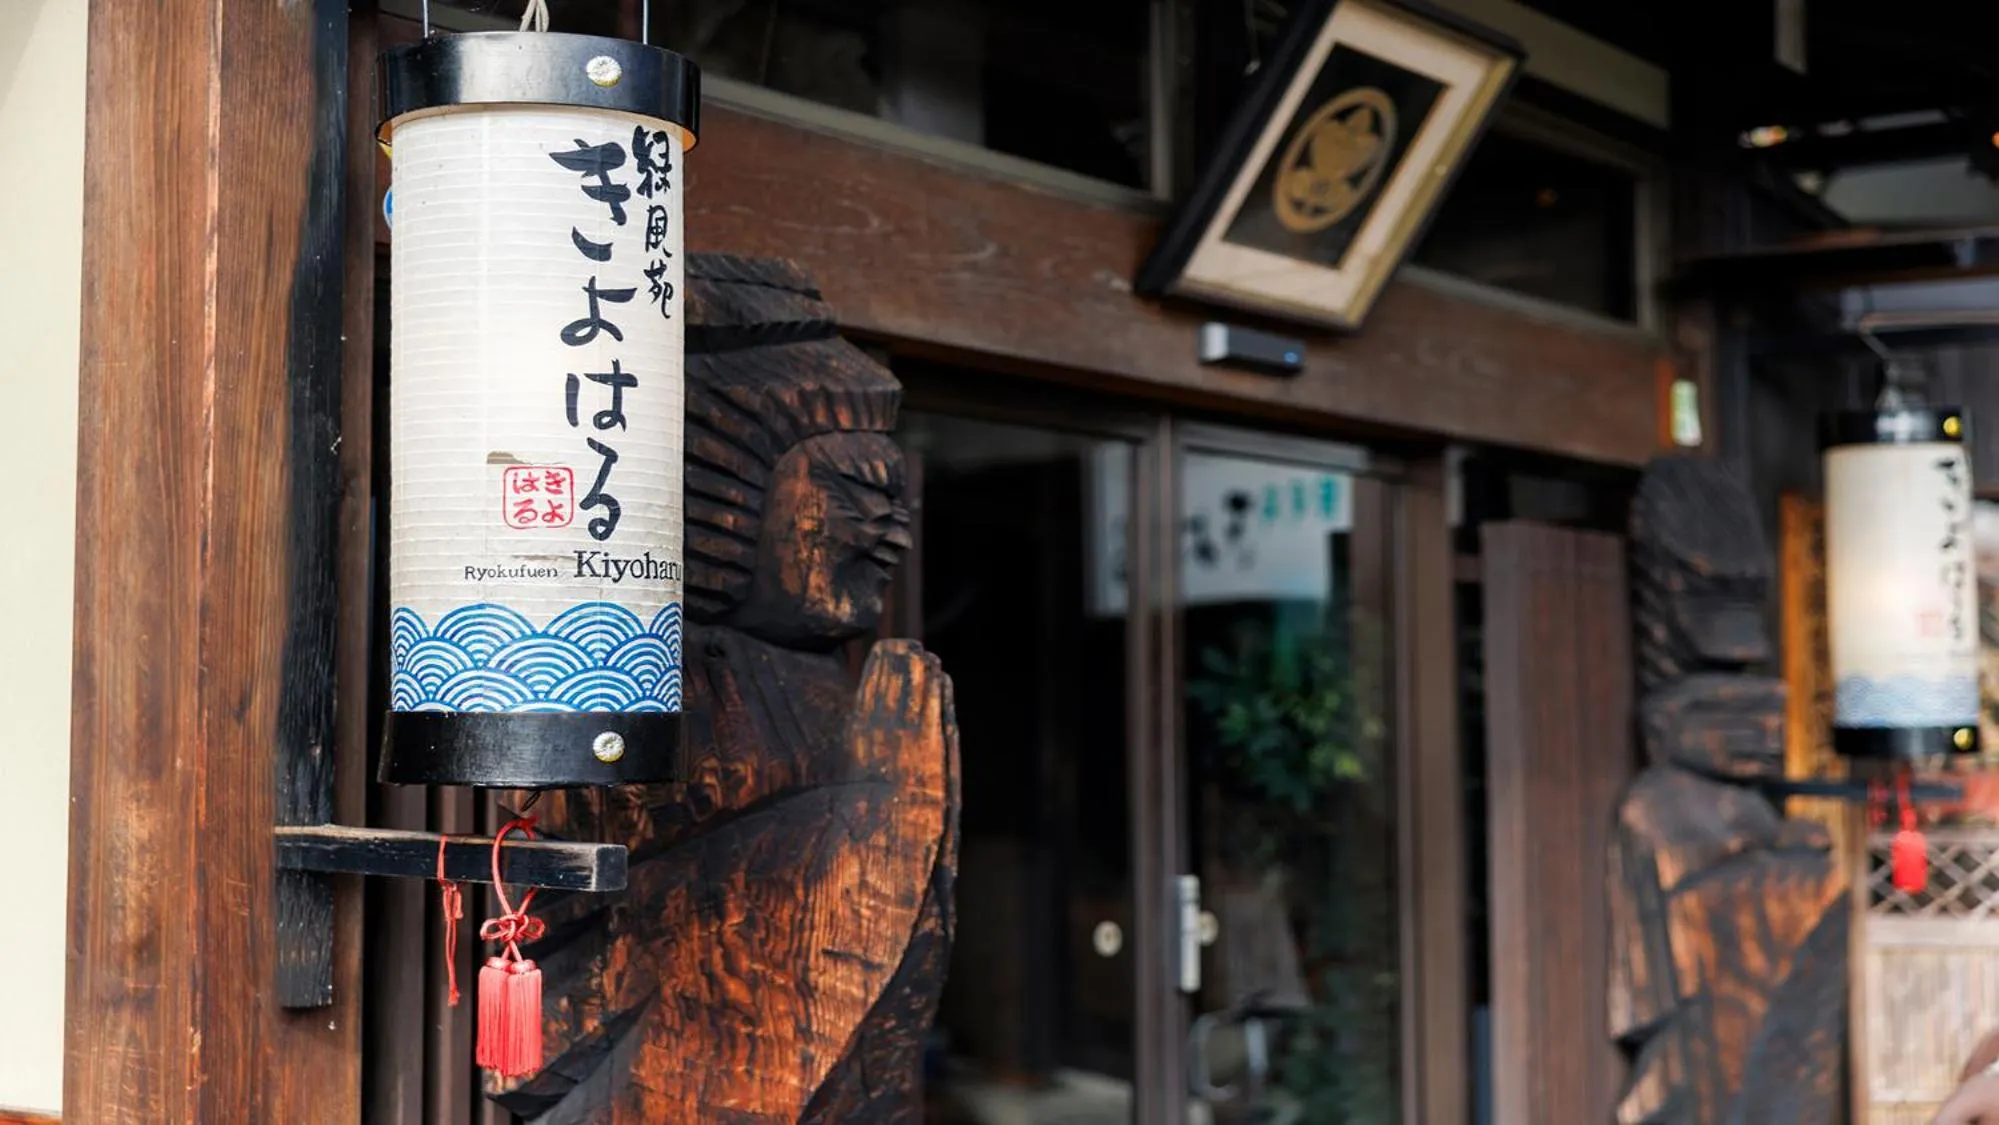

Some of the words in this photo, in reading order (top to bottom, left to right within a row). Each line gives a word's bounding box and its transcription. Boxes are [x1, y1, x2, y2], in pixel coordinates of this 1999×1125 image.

[632, 125, 674, 319] 緑風苑
[549, 138, 638, 541] きよはる
[464, 564, 558, 581] Ryokufuen
